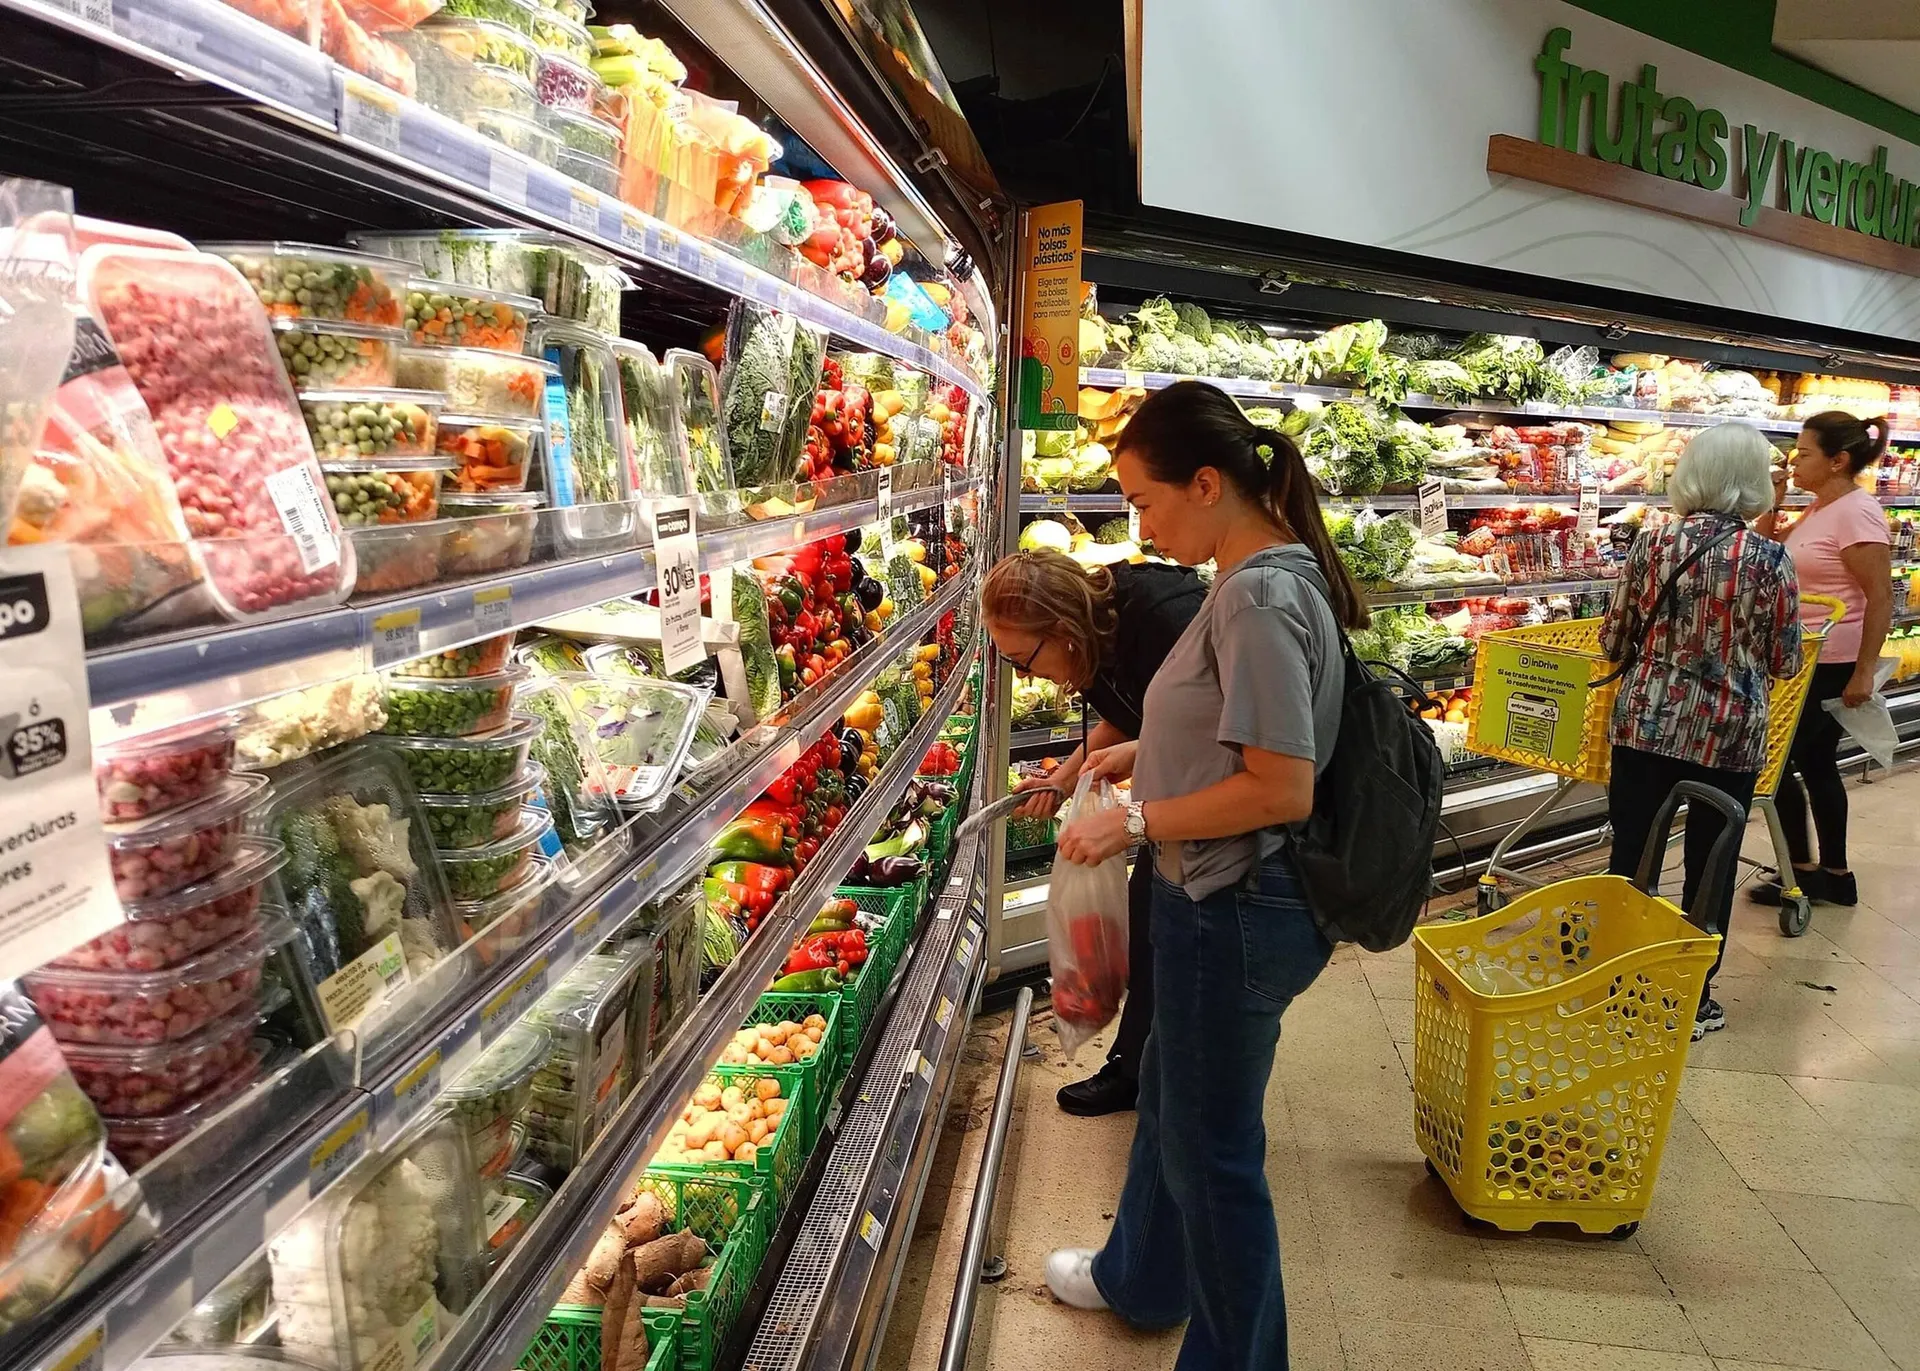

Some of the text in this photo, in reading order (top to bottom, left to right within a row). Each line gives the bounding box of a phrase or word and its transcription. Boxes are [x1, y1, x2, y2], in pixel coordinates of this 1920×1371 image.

[1536, 27, 1728, 191] frutas
[1740, 124, 1780, 226] y
[1038, 223, 1071, 239] No más
[1039, 239, 1067, 251] bolsas
[1038, 277, 1068, 288] Elige traer
[1038, 287, 1067, 297] tus bolsas
[1034, 297, 1070, 308] reutilizables
[1033, 311, 1048, 320] para
[1531, 658, 1559, 671] inDrive
[1512, 670, 1528, 680] trata
[1537, 675, 1556, 685] hacer
[1512, 680, 1547, 692] resolvemos
[1546, 685, 1566, 695] juntos
[1511, 703, 1535, 712] entregas
[13, 722, 61, 757] 35%
